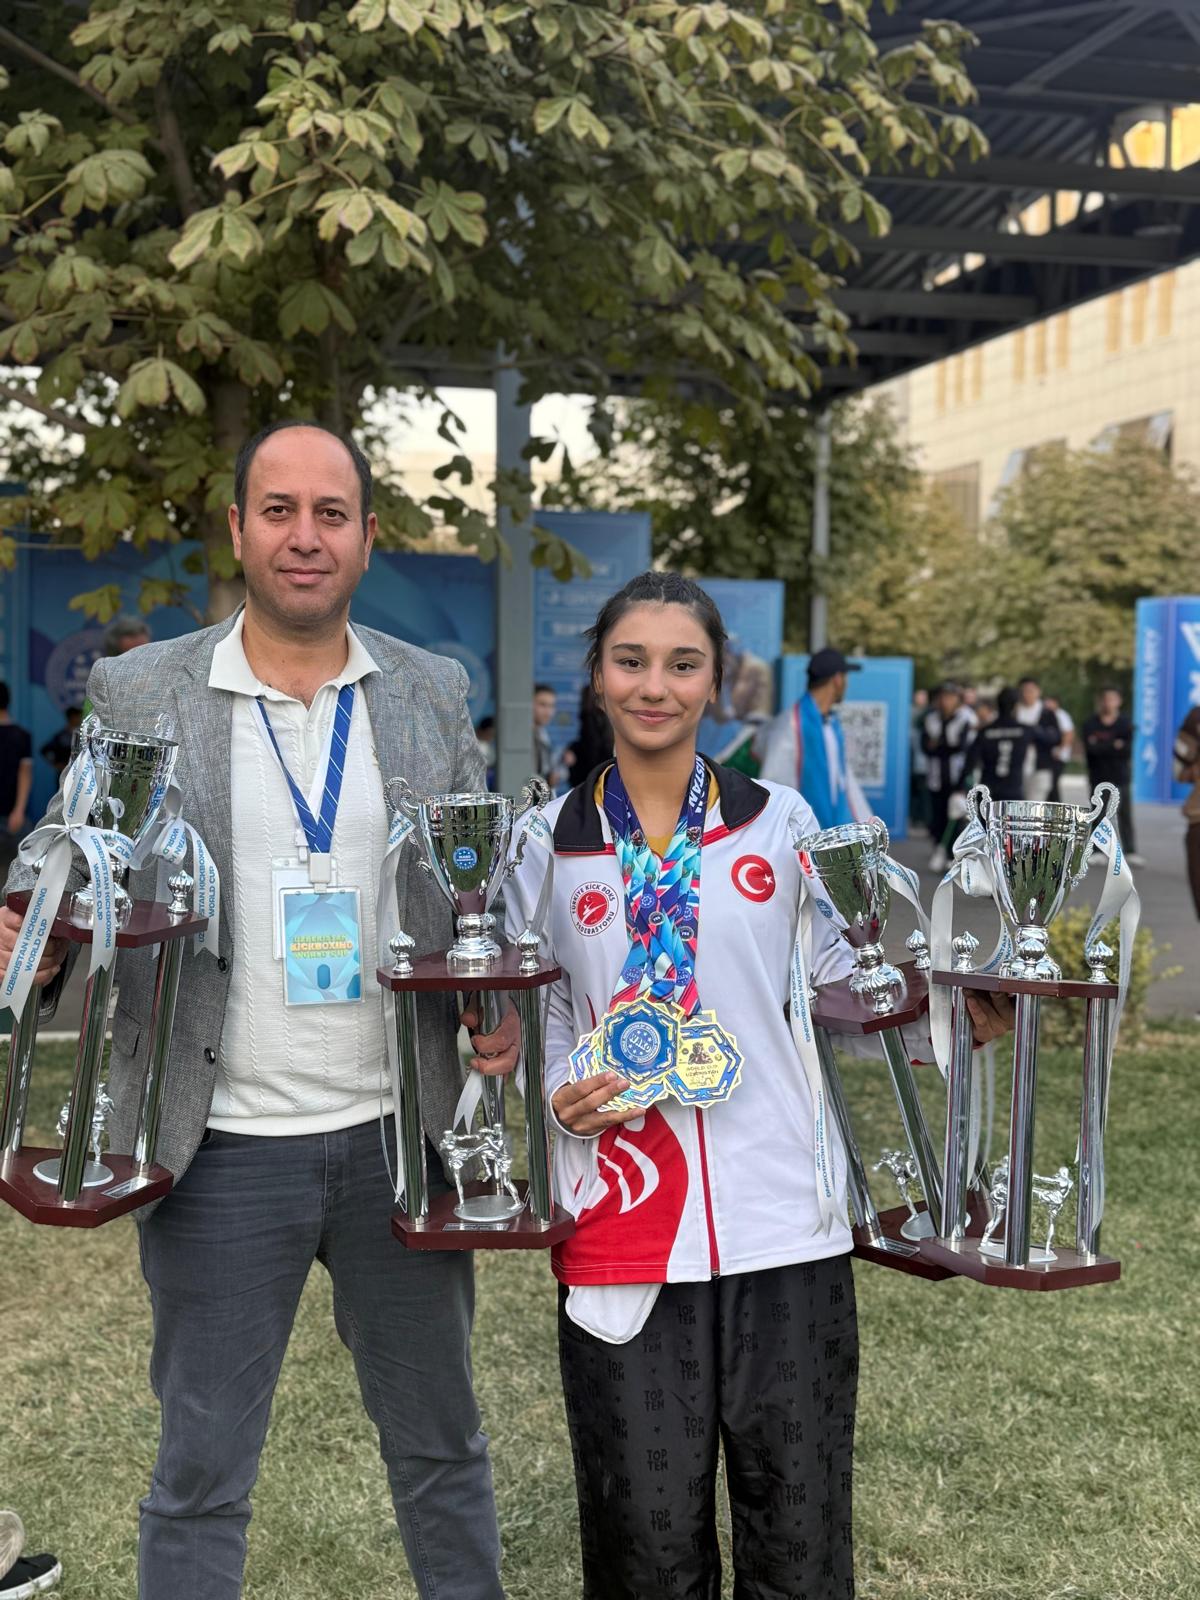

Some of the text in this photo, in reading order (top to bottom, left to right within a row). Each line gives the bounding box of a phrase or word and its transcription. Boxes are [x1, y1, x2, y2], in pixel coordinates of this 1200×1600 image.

[67, 763, 92, 818] UZBEKISTAN
[528, 824, 544, 838] CUP
[1093, 830, 1108, 846] CUP
[90, 834, 110, 890] UZBEKISTAN
[104, 891, 112, 949] KICKBOXING
[93, 863, 104, 921] WORLD CUP
[208, 865, 217, 918] WORLD CUP
[601, 886, 616, 902] BOKS
[5, 887, 48, 996] UZBEKISTAN KICKBOXING
[24, 918, 48, 972] WORLD CUP
[799, 991, 811, 1043] KICKBOXING
[677, 1304, 695, 1315] TOP
[770, 1302, 790, 1314] TOP
[679, 1314, 697, 1325] TEN
[771, 1312, 791, 1324] TEN
[608, 1358, 624, 1371] TOP
[680, 1359, 699, 1371] TOP
[776, 1360, 796, 1372] TOP
[608, 1369, 625, 1381] TEN
[680, 1369, 700, 1381] TEN
[777, 1371, 797, 1383] TEN
[644, 1388, 664, 1400] TOP
[644, 1399, 664, 1412] TEN
[683, 1416, 704, 1427] TOP
[782, 1420, 802, 1433] TOP
[684, 1426, 705, 1439] TEN
[782, 1432, 803, 1445] TEN
[646, 1449, 668, 1461] TOP
[647, 1460, 669, 1472] TEN
[785, 1482, 806, 1495] TOP
[785, 1494, 807, 1507] TEN
[650, 1509, 671, 1521] TOP
[651, 1519, 672, 1532] TEN
[787, 1540, 807, 1552] TOP
[787, 1550, 808, 1562] TEN
[655, 1566, 677, 1577] TOP
[656, 1576, 678, 1586] TEN
